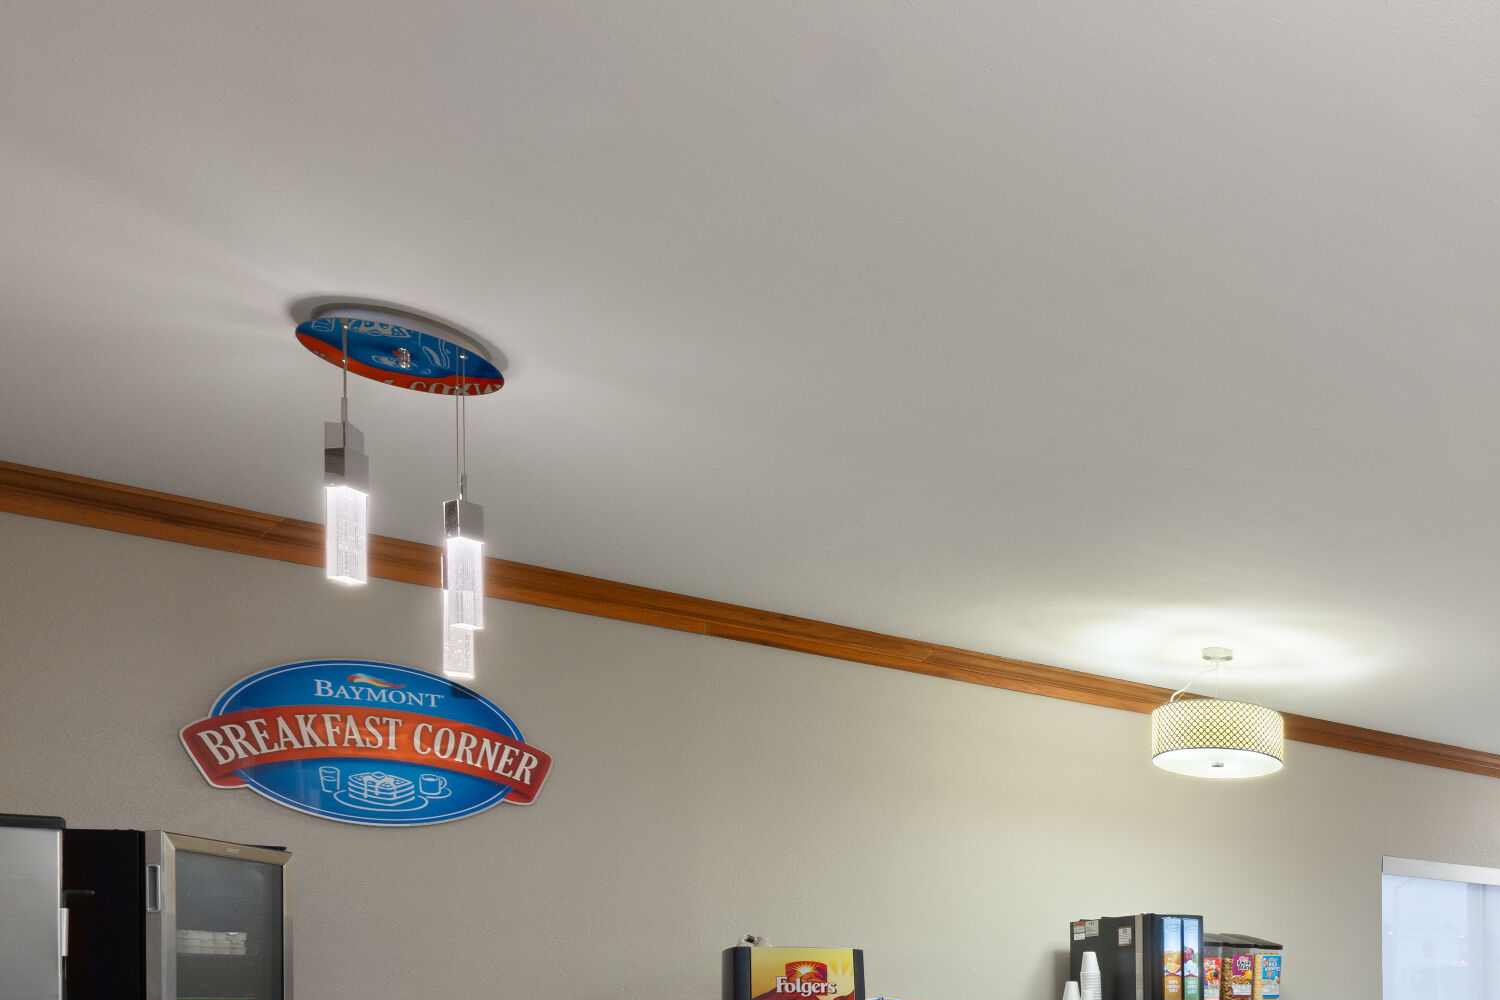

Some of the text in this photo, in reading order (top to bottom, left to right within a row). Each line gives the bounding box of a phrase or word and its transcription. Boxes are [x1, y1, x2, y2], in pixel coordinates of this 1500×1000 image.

[313, 679, 441, 708] BAYMONT
[197, 713, 539, 785] BREAKFAST CORNER
[776, 976, 837, 997] Folgers
